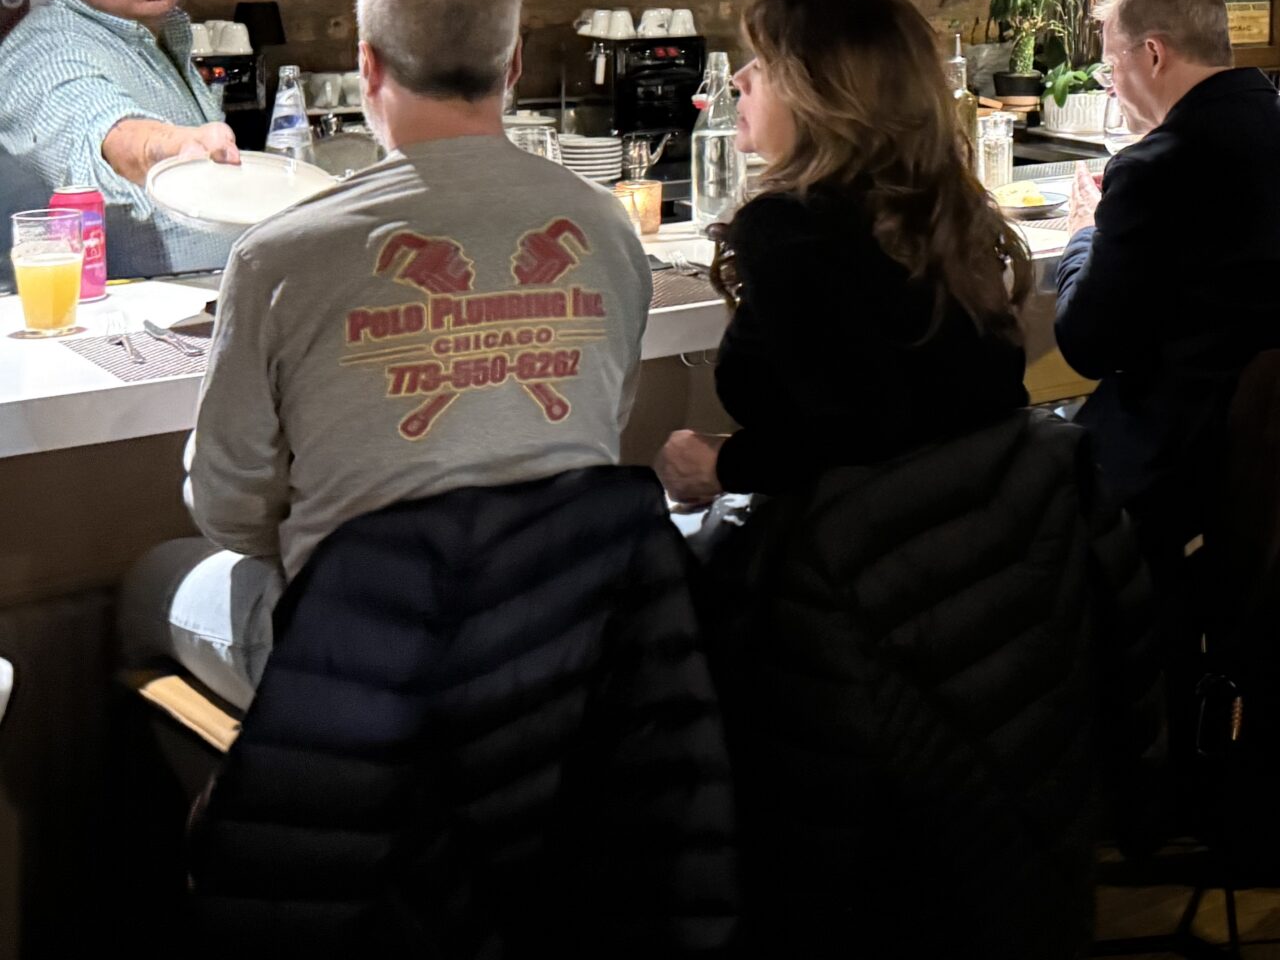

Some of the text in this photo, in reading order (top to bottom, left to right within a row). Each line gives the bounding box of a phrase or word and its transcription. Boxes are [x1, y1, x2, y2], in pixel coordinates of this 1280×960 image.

[347, 303, 426, 343] POLO
[430, 291, 567, 331] PLUMBING
[433, 327, 554, 357] CHICAGO
[386, 348, 581, 396] 773-550-6262
